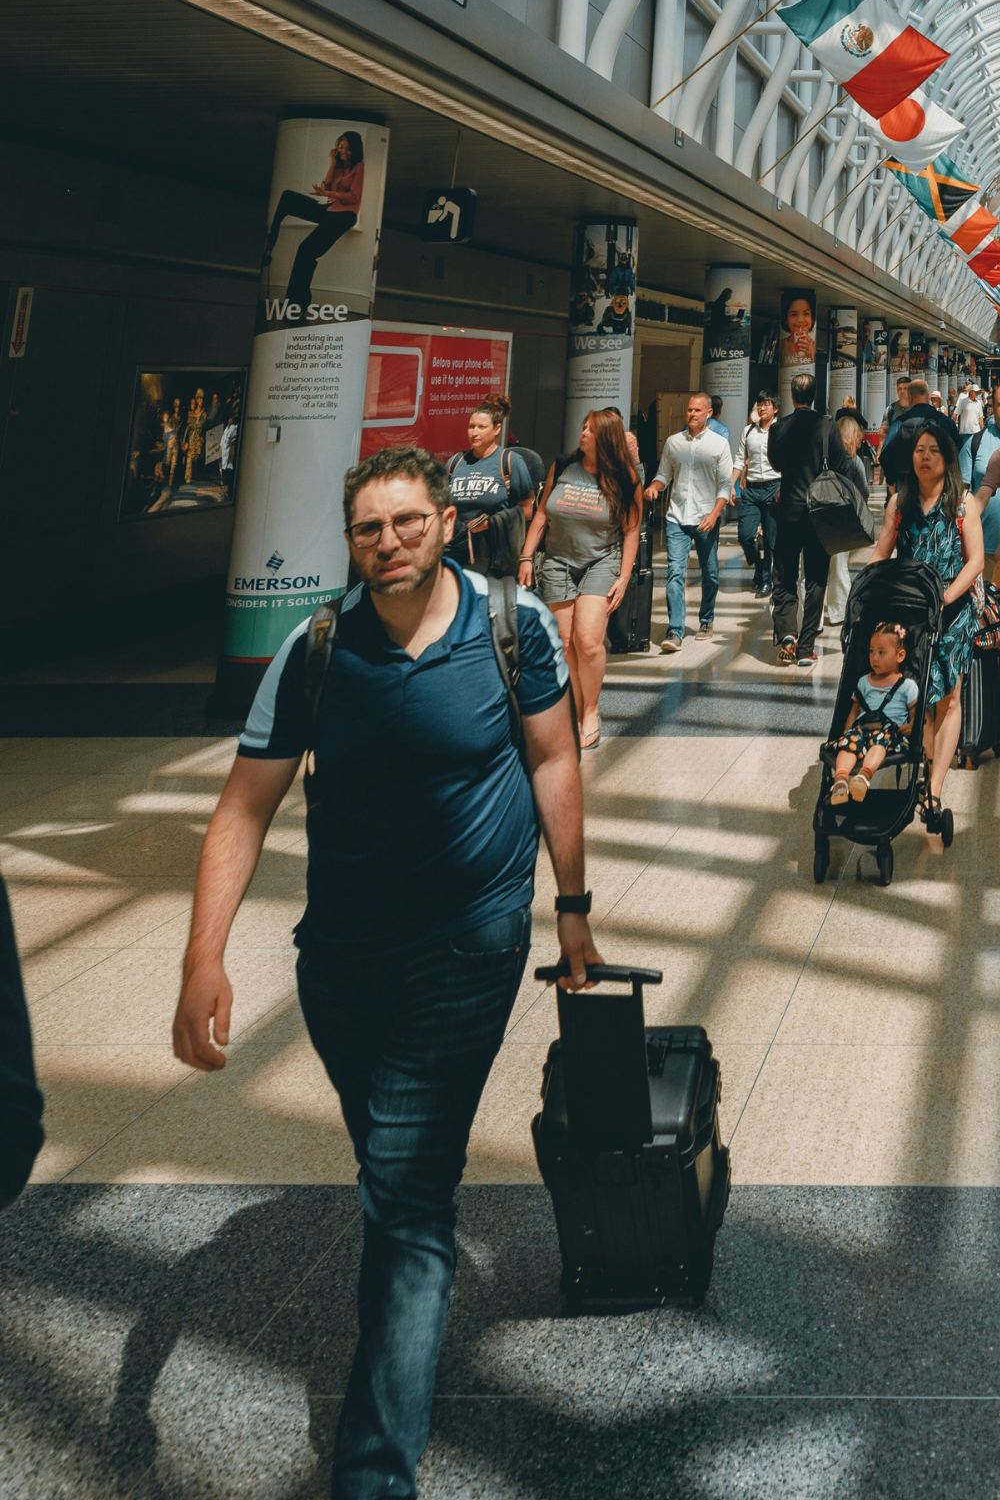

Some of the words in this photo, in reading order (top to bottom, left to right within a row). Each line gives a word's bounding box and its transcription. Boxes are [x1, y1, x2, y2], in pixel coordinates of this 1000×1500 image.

[266, 298, 301, 320] We
[306, 304, 348, 320] see
[292, 334, 325, 343] working
[574, 336, 596, 350] We
[600, 338, 622, 350] see
[286, 343, 323, 351] industrial
[324, 343, 344, 352] plant
[710, 348, 726, 358] We
[729, 349, 744, 358] see
[285, 352, 306, 361] being
[275, 362, 299, 370] sitting
[432, 357, 450, 368] Before
[452, 359, 464, 370] your
[465, 358, 482, 370] phone
[431, 376, 441, 385] use
[455, 375, 464, 387] get
[291, 384, 312, 393] safety
[316, 401, 338, 409] facility.
[449, 481, 465, 493] AL
[466, 480, 499, 494] NEVA
[234, 575, 320, 591] EMERSON
[271, 599, 284, 608] IT
[286, 594, 332, 607] SOLVED
